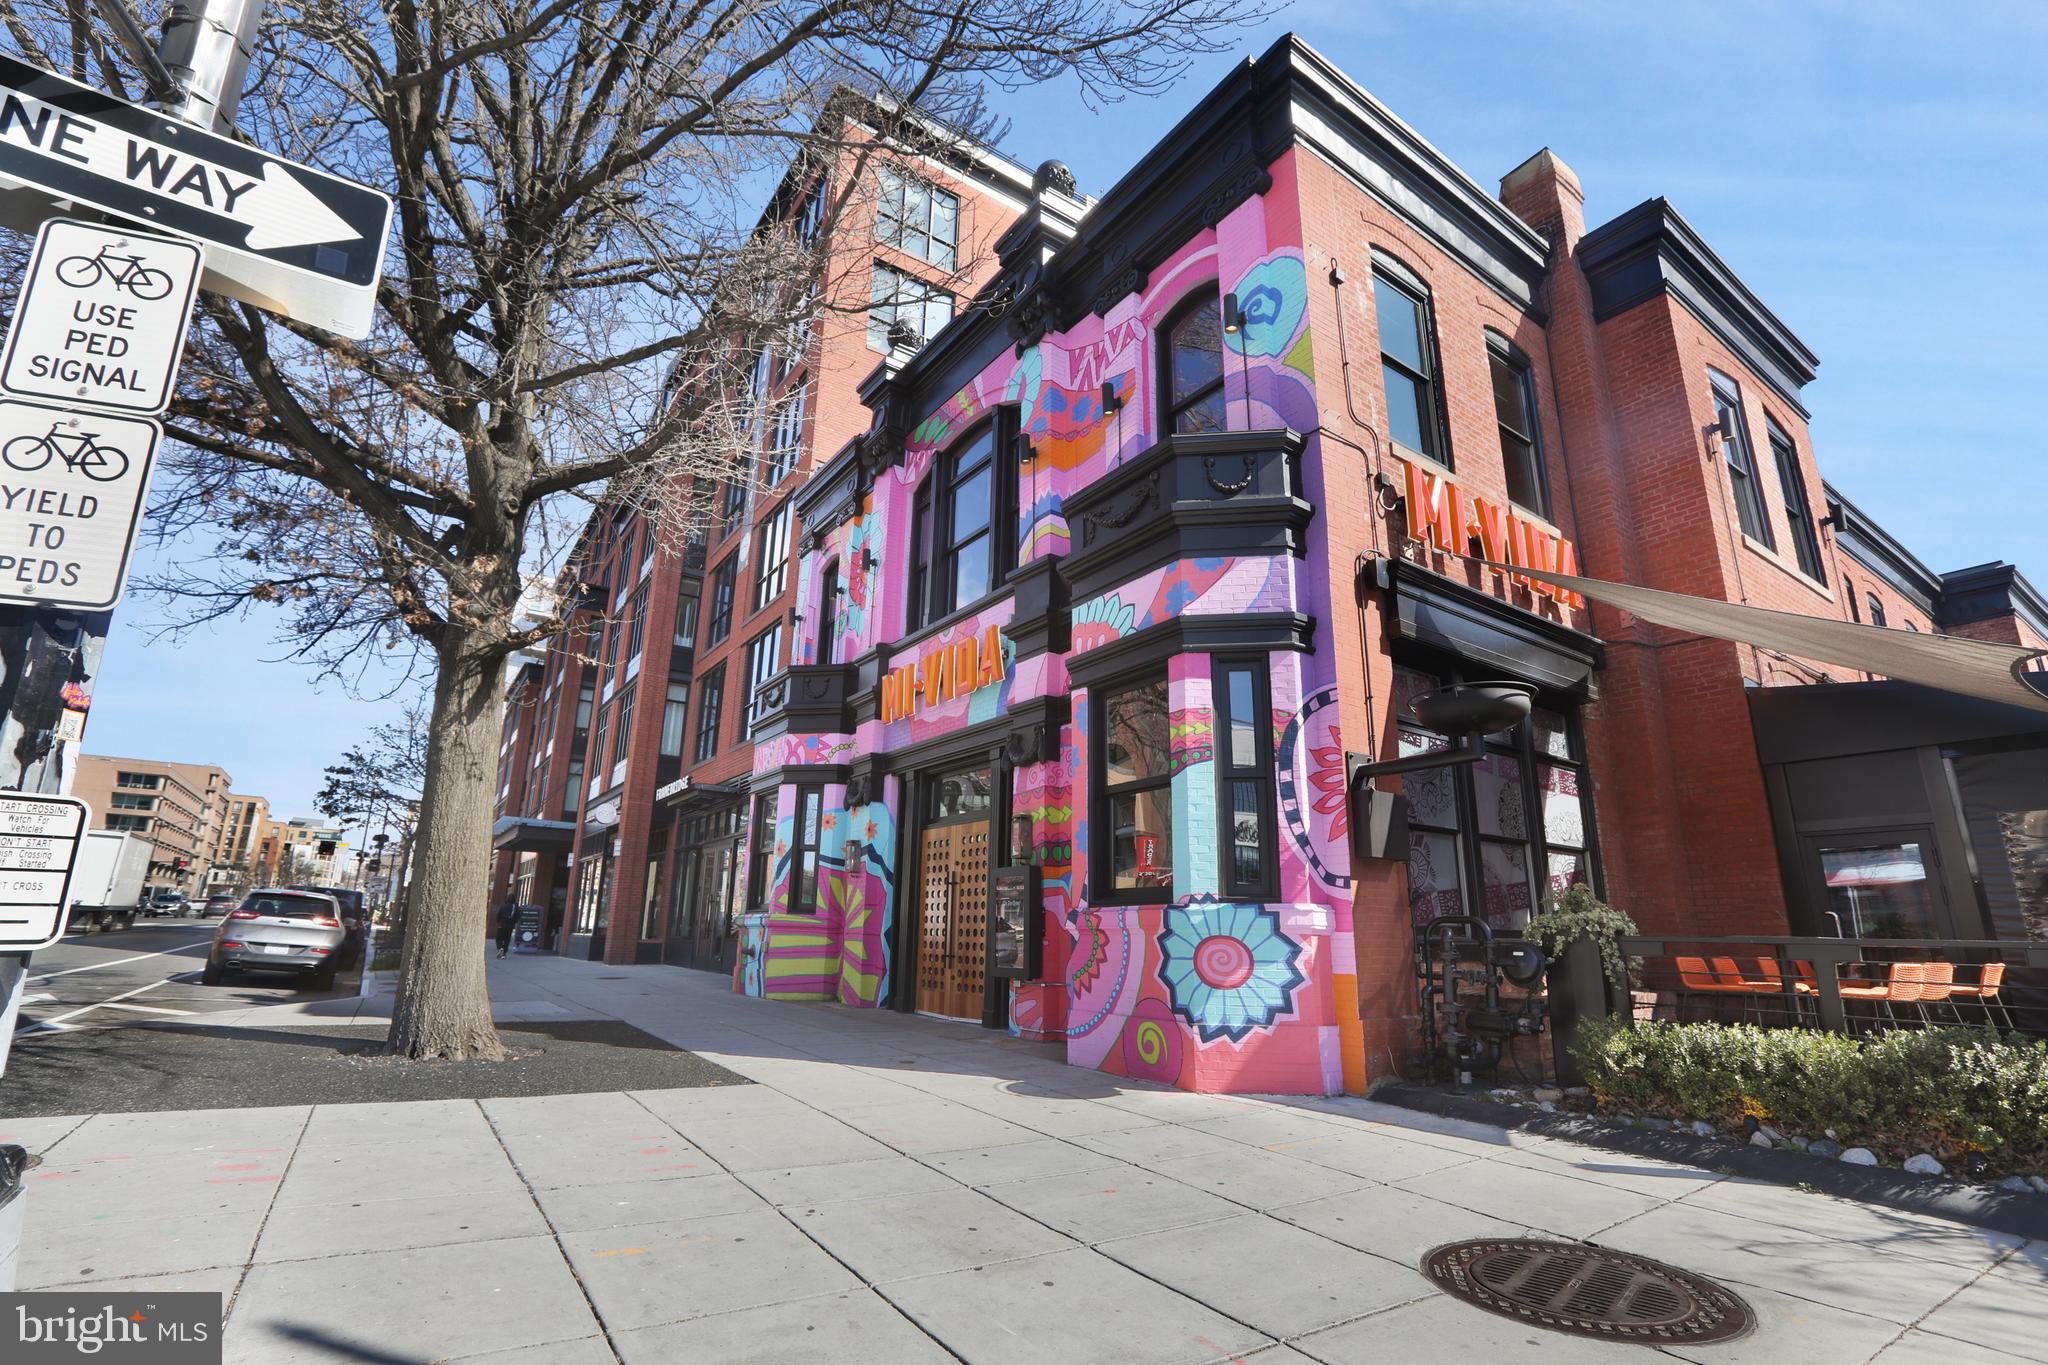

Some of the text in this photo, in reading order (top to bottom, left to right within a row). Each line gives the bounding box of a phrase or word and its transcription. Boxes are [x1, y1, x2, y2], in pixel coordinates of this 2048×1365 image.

[0, 94, 258, 214] NE WAY
[73, 300, 138, 330] USE
[64, 329, 129, 357] PED
[28, 355, 147, 392] SIGNAL
[1, 484, 98, 519] YIELD
[28, 523, 65, 550] TO
[0, 555, 81, 586] PEDS
[0, 801, 69, 815] TART CROSSING
[8, 813, 50, 824] Watch For
[11, 823, 44, 834] Vehicles
[0, 836, 52, 848] ON'T START
[19, 849, 52, 860] Crossing
[19, 858, 47, 868] Started
[13, 881, 43, 891] CROSS
